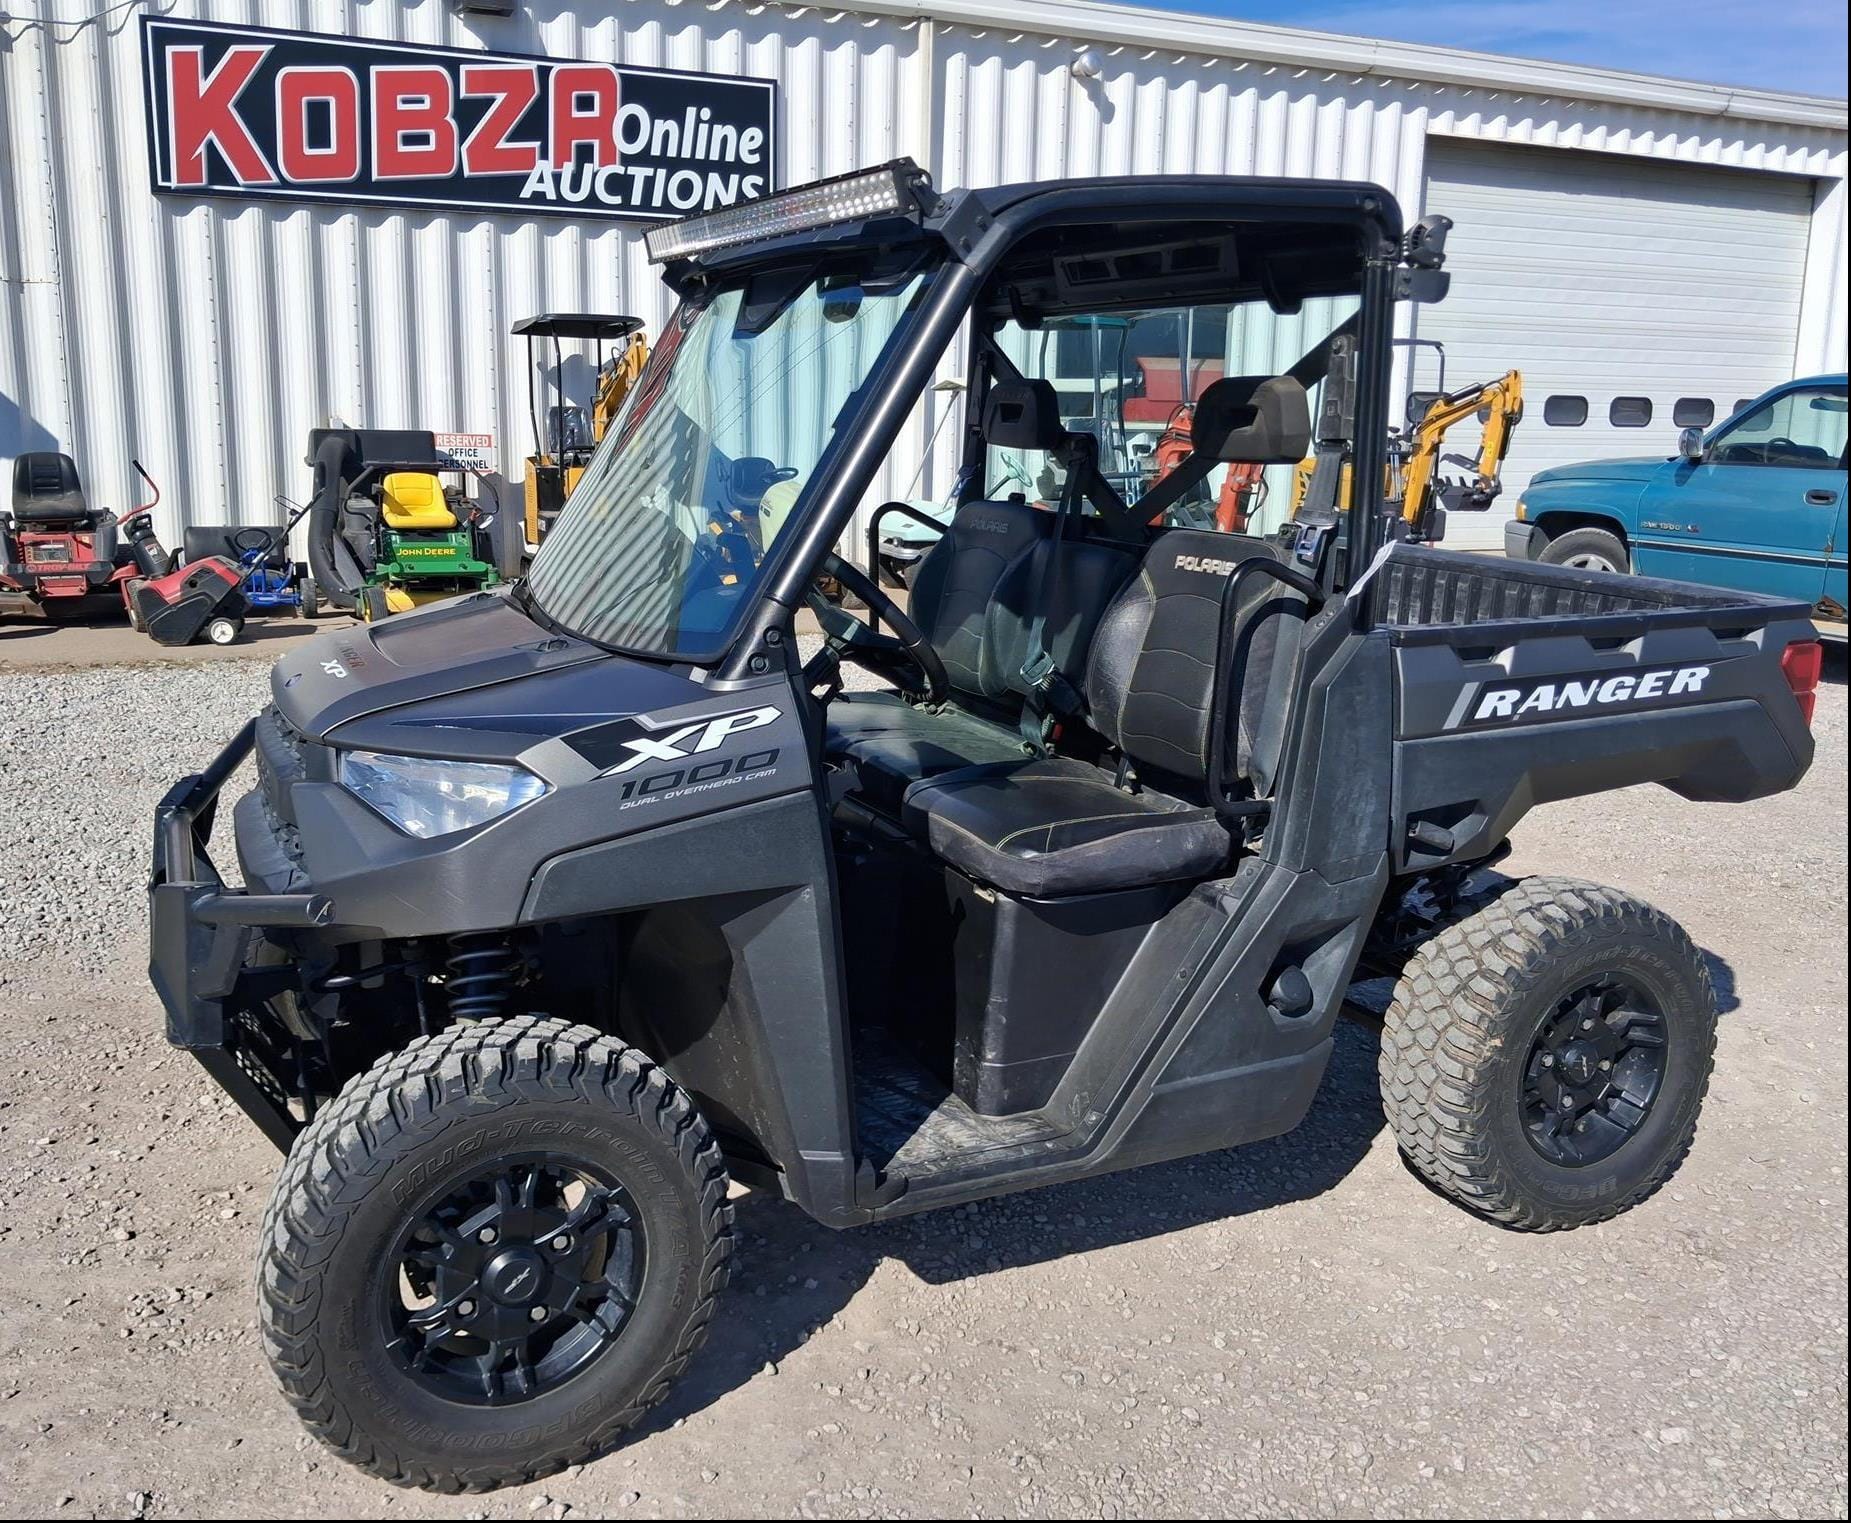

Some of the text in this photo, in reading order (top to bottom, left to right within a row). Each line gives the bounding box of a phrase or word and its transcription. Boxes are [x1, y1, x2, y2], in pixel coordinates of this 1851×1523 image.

[164, 44, 622, 188] KOBZA
[612, 103, 764, 165] Online
[519, 160, 764, 212] AUCTIONS
[436, 434, 489, 447] RESERVED
[448, 447, 479, 458] OFFICE
[396, 547, 457, 556] JOHN DEERE
[1174, 555, 1237, 577] POLARIS
[319, 658, 348, 678] XP
[1473, 666, 1710, 721] RANGER
[598, 704, 784, 778] XP
[619, 747, 781, 801] 1000
[619, 767, 777, 811] DUAL OVERHEAD CAM
[391, 1117, 667, 1205] Mud-Terrain
